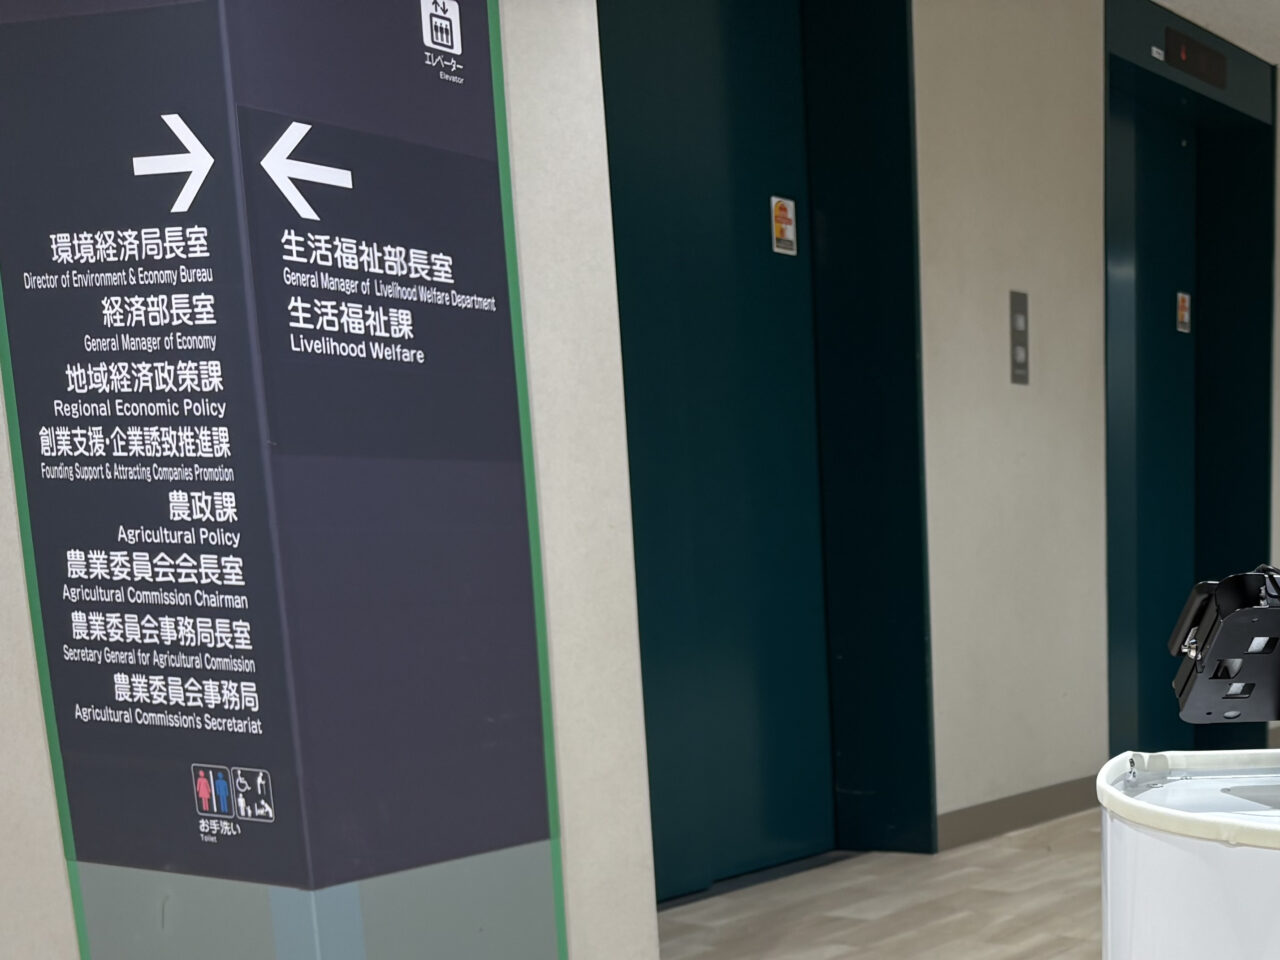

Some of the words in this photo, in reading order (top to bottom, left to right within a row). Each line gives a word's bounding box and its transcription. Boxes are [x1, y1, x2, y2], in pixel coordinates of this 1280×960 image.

[49, 225, 210, 264] 環境経済局長室
[281, 229, 454, 284] 生活福祉部長室
[23, 272, 58, 289] Director
[61, 270, 70, 288] of
[72, 269, 127, 287] Environment
[128, 267, 137, 285] &
[138, 267, 178, 286] Economy
[179, 265, 213, 283] Bureau
[283, 267, 319, 288] General
[320, 272, 359, 295] Manager
[361, 278, 370, 295] of
[374, 279, 418, 301] Livelihood
[418, 285, 450, 305] Welfare
[101, 292, 217, 328] 経済部長室
[287, 296, 414, 340] 生活福祉課
[84, 334, 119, 352] General
[121, 333, 161, 353] Manager
[164, 332, 174, 350] of
[176, 332, 216, 351] Economy
[290, 333, 366, 358] Livelihood
[369, 341, 424, 363] Welfare
[65, 360, 224, 393] 地域経済政策課
[54, 399, 111, 419] Regional
[115, 398, 179, 416] Economic
[183, 398, 226, 418] Policy
[105, 462, 112, 479] &
[168, 489, 238, 523] 農政課
[118, 525, 196, 544] Agricultural
[199, 527, 240, 548] Policy
[66, 549, 245, 586] 農業委員会会長室
[63, 584, 125, 602] Agricultural
[127, 586, 192, 606] Commission
[194, 589, 248, 609] Chairman
[71, 610, 253, 650] 農業委員会事務局長室
[63, 644, 102, 664] Secretary
[104, 647, 136, 664] General
[137, 649, 150, 665] for
[153, 650, 203, 669] Agricultural
[204, 653, 256, 672] Commission
[113, 672, 259, 712] 農業委員会事務局
[75, 704, 133, 723] Agricultural
[135, 708, 202, 729] Commission's
[204, 713, 263, 734] Secretariat
[199, 819, 241, 835] お手洗い
